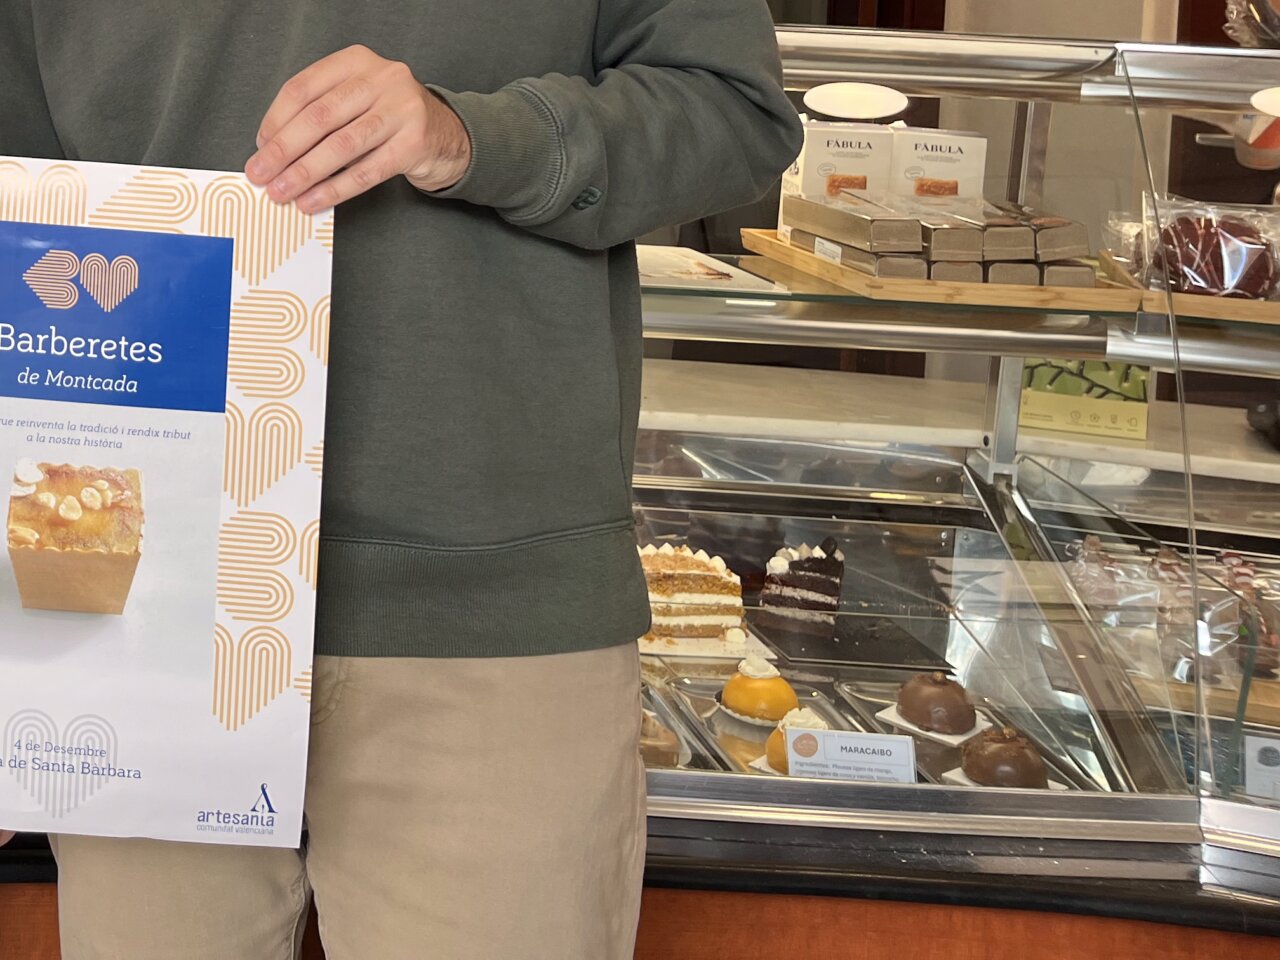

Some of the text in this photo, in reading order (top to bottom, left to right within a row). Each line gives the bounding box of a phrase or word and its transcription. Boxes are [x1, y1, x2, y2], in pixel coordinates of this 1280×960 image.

[17, 367, 138, 392] de Montcada
[16, 419, 64, 430] reinventa
[67, 421, 77, 431] la
[80, 424, 119, 435] tradició
[127, 427, 160, 438] rendix
[163, 429, 191, 440] tribut
[26, 433, 123, 449] a la nostra història
[14, 739, 107, 758] 4 de Desembre
[840, 746, 892, 757] MARACAIBO
[8, 755, 27, 769] de
[31, 757, 75, 774] Santa
[196, 824, 274, 835] comunitat valenciana
